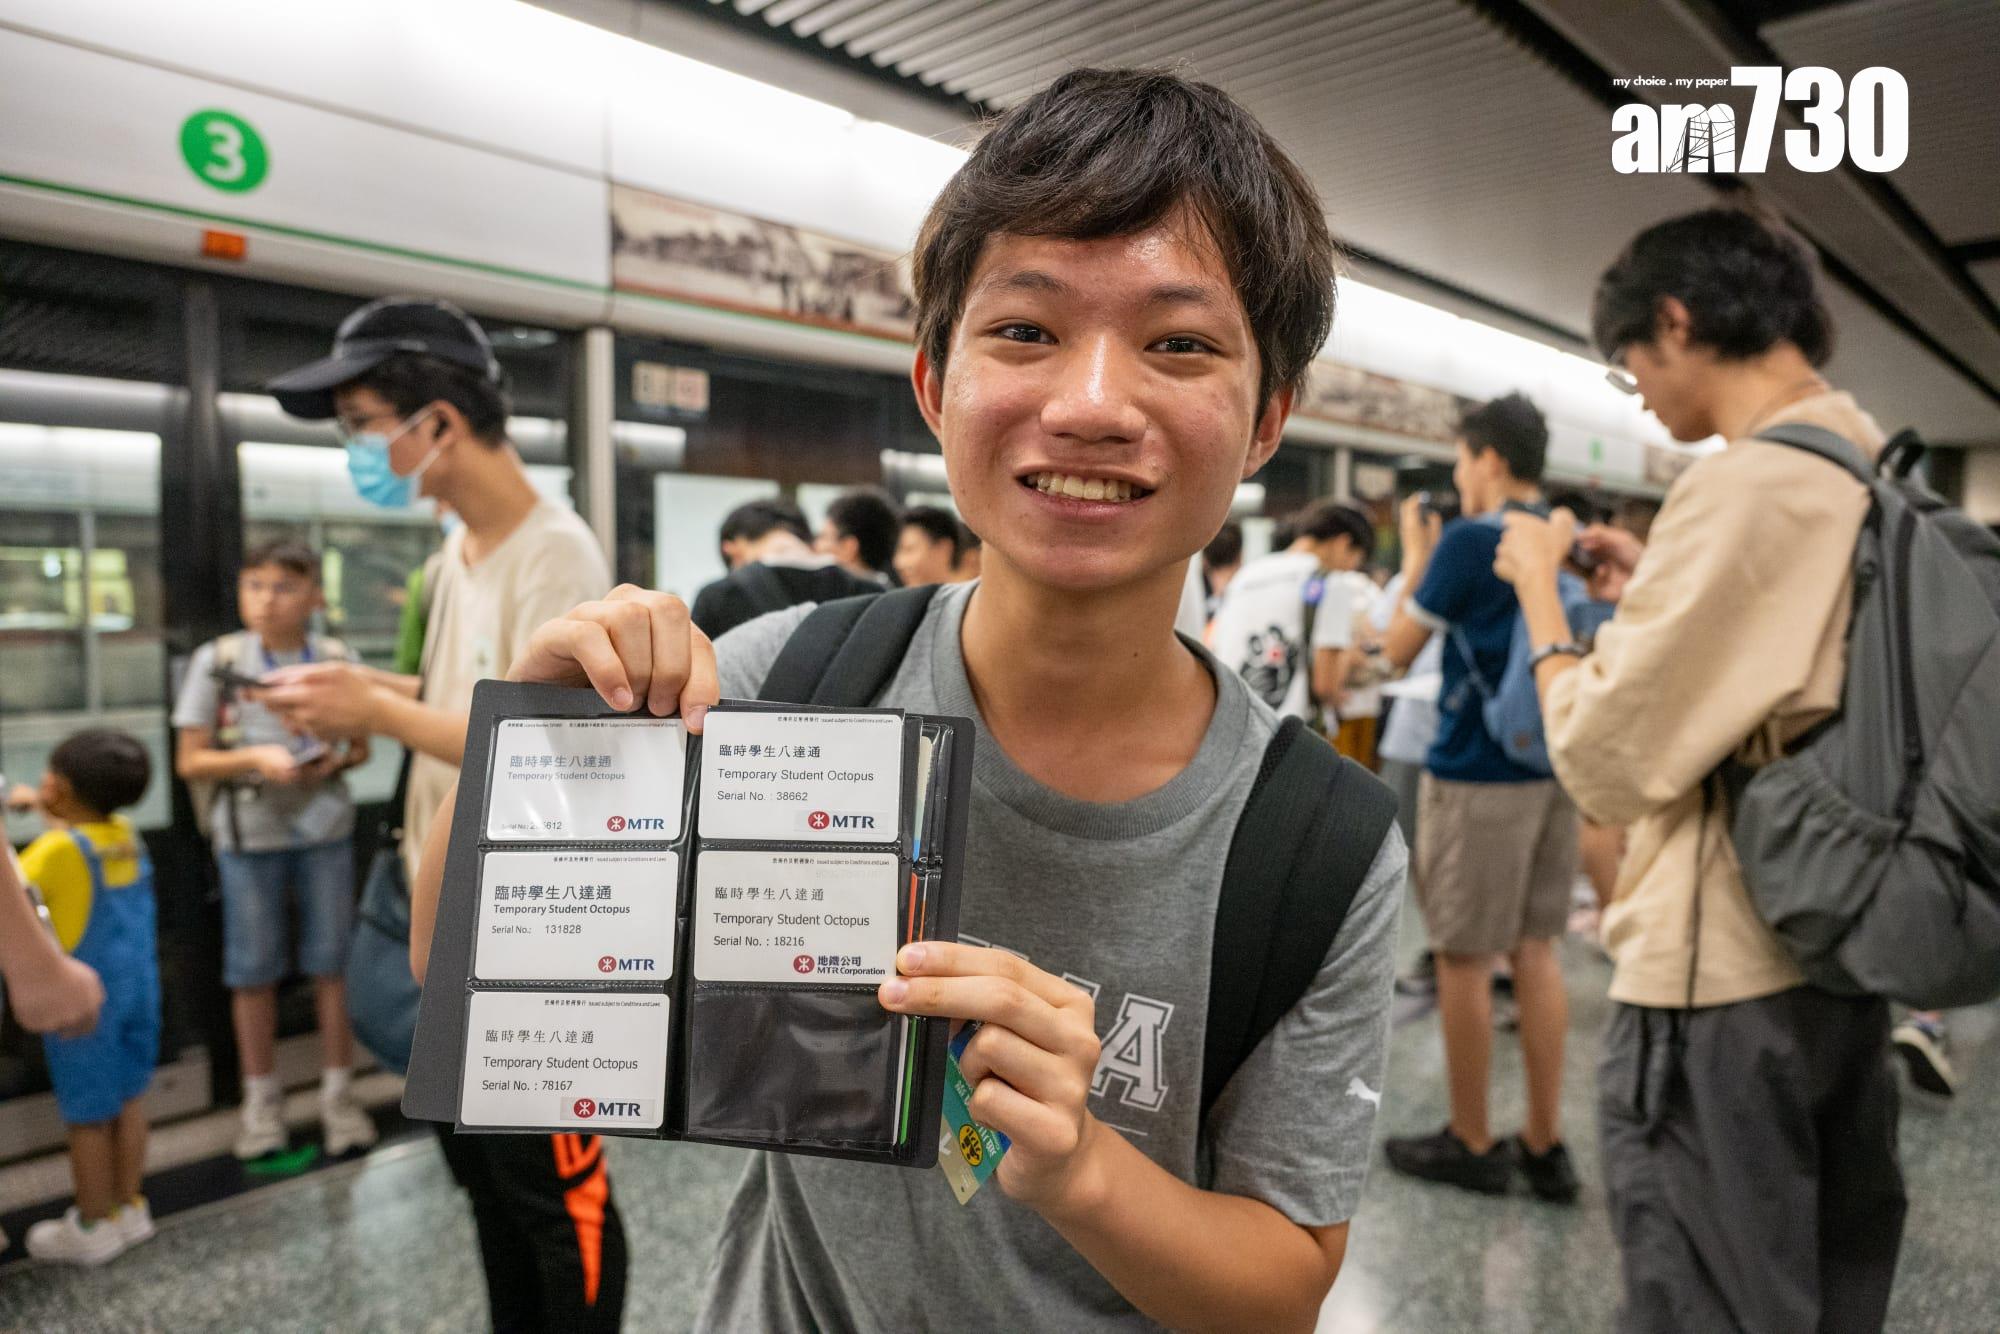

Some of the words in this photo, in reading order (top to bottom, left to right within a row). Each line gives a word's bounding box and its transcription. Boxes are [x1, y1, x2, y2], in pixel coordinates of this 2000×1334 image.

[202, 120, 248, 183] 3
[719, 744, 821, 758] 臨時學生八達通
[510, 755, 612, 768] 臨時學生八達通
[508, 772, 553, 781] Temporary
[555, 772, 588, 780] Student
[590, 773, 625, 781] Octopus
[718, 769, 777, 781] Temporary
[781, 770, 824, 780] Student
[828, 771, 874, 782] Octopus
[717, 791, 746, 801] Serial
[776, 792, 808, 801] 38662
[628, 819, 664, 830] MTR
[833, 815, 874, 829] MTR
[494, 885, 612, 900] 臨時學生八達通
[715, 887, 824, 901] 臨時學生八達通
[494, 905, 546, 916] Temporary
[549, 905, 587, 914] Student
[590, 905, 630, 915] Octopus
[713, 913, 773, 926] Temporary
[778, 914, 820, 926] Student
[824, 915, 870, 927] Octopus
[492, 925, 513, 934] Serial
[545, 925, 582, 934] 131828
[713, 936, 742, 946] Serial
[745, 936, 762, 946] No.
[775, 937, 805, 946] 18216
[619, 959, 655, 971] MTR
[818, 956, 861, 966] 地鐵公司
[840, 967, 886, 975] Corporation
[485, 1030, 594, 1043] 臨時學生八達通
[483, 1056, 542, 1070] Temporary
[546, 1057, 589, 1069] Student
[593, 1058, 638, 1070] Octopus
[482, 1081, 509, 1091] Serial
[514, 1081, 529, 1091] No.
[542, 1081, 572, 1091] 78167
[599, 1102, 641, 1116] MTR
